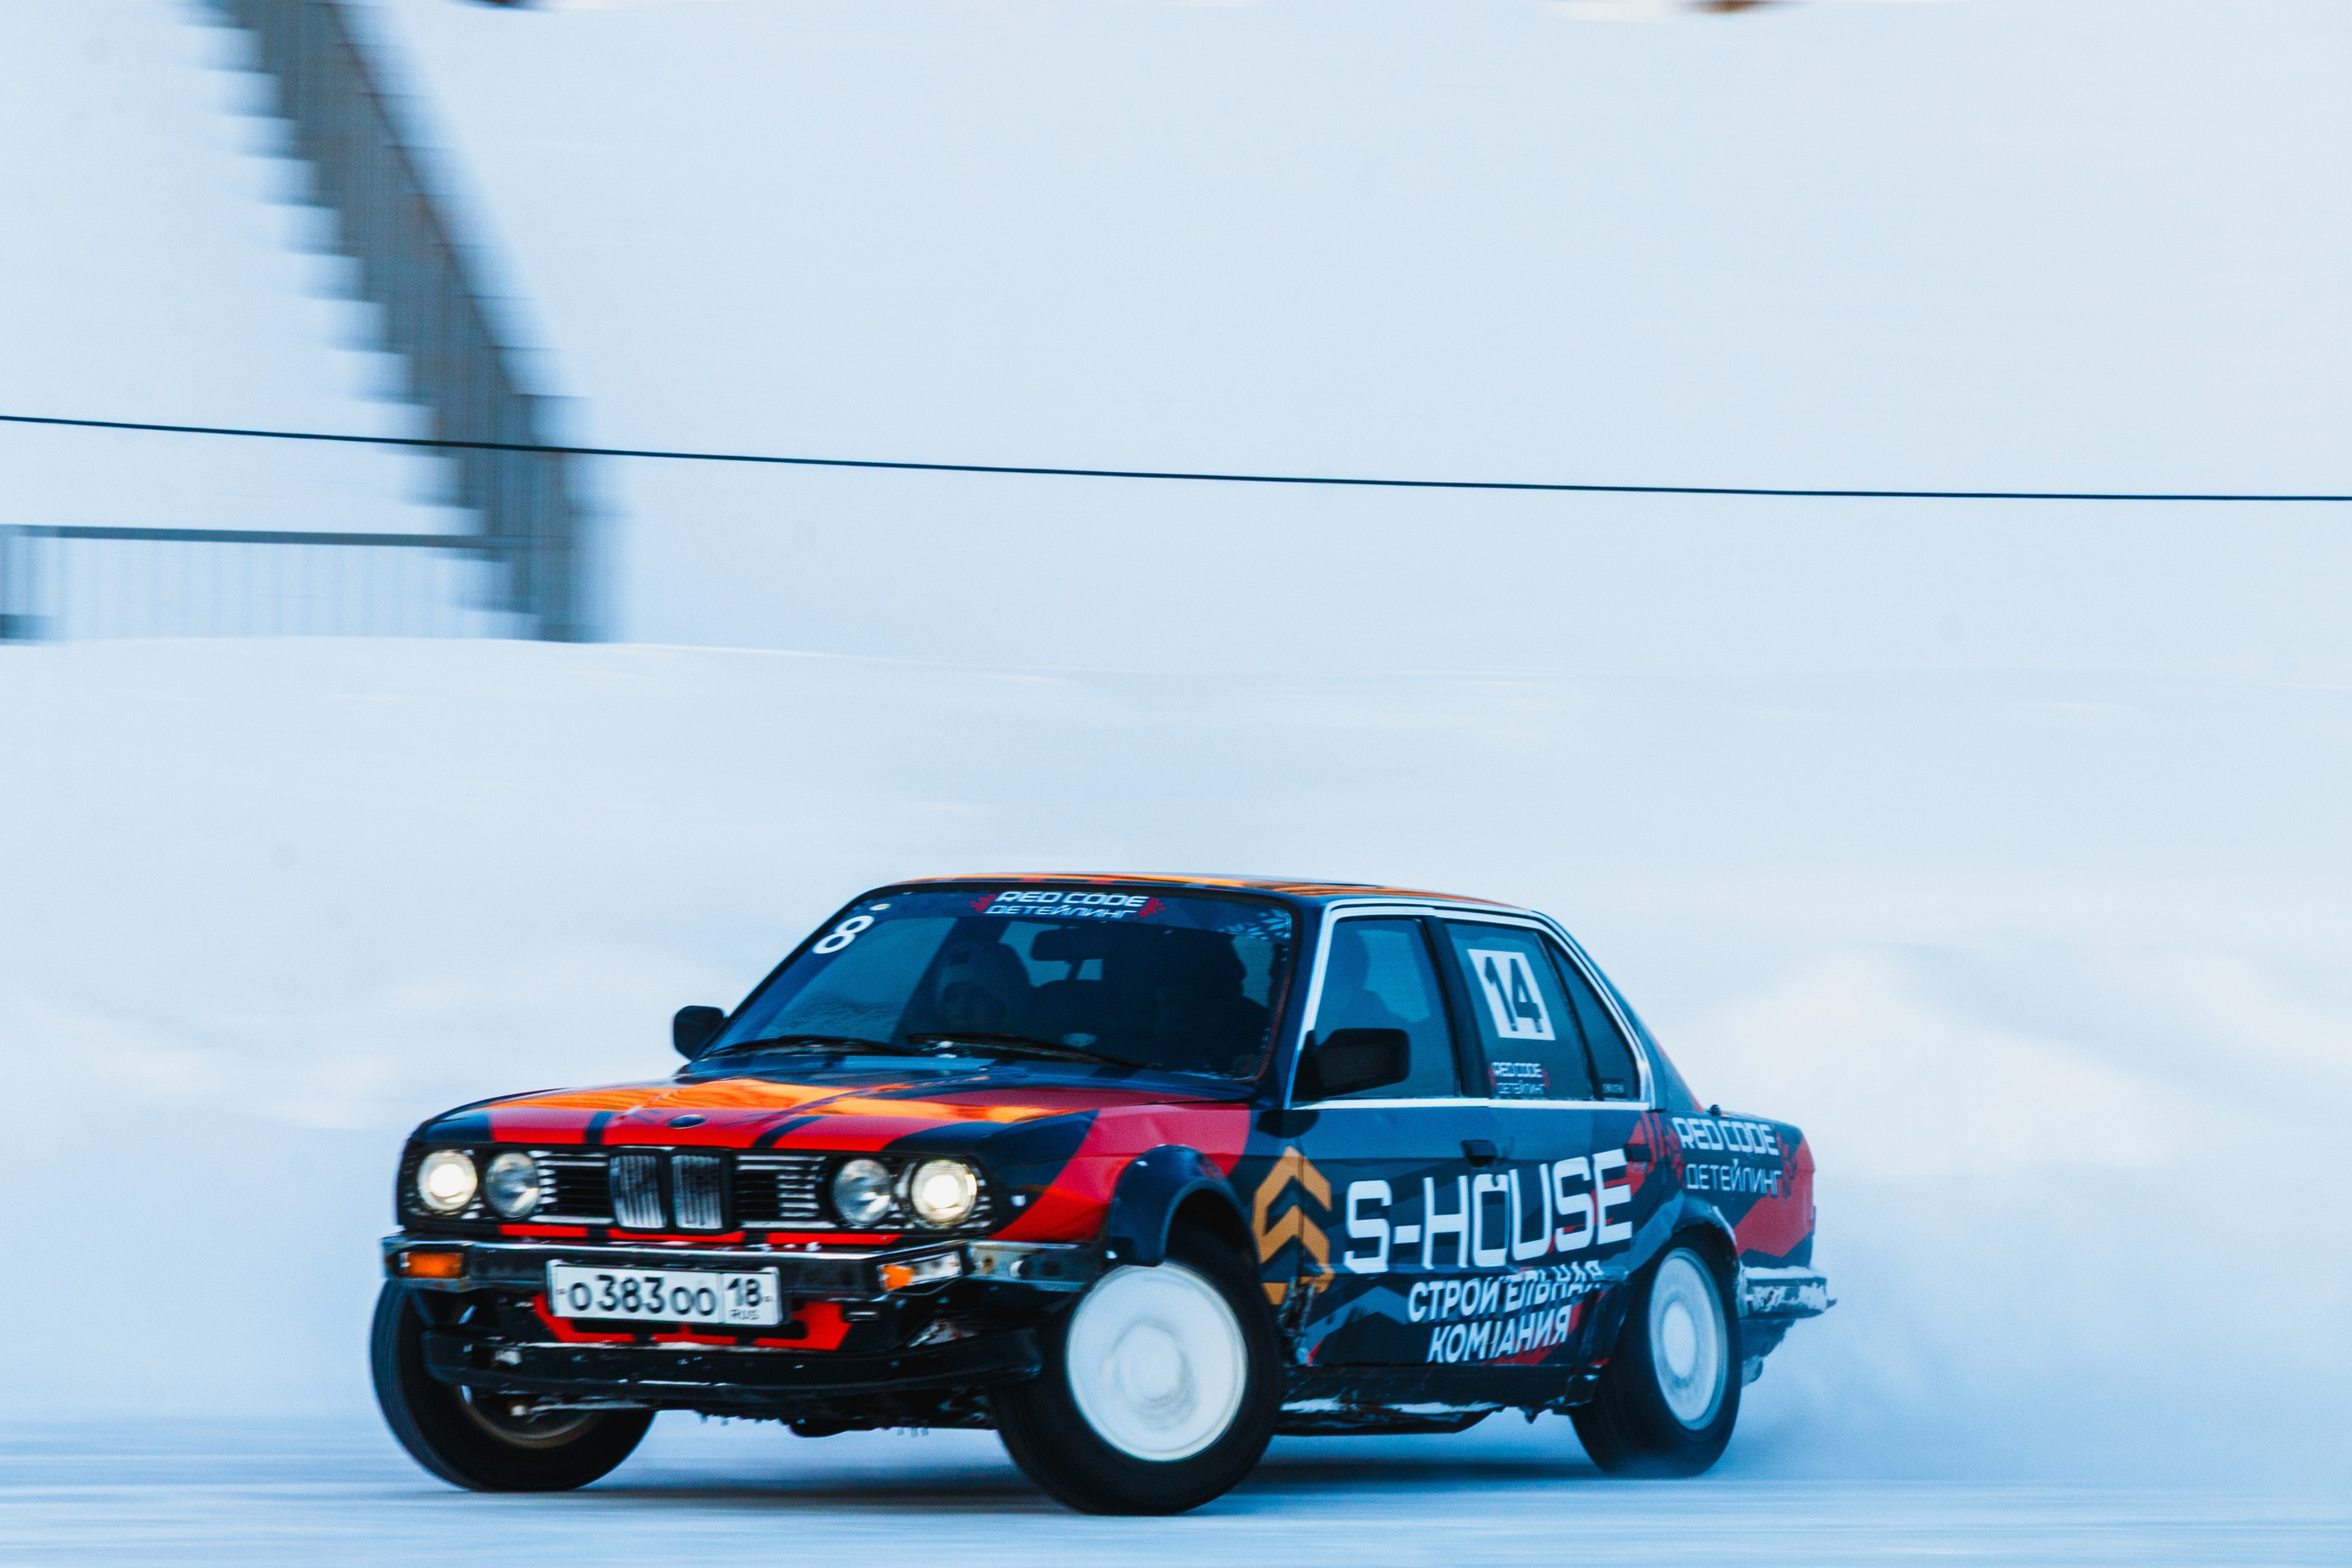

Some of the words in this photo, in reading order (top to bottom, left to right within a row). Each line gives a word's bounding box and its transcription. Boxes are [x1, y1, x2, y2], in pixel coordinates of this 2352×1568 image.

[995, 891, 1061, 903] RED
[1064, 892, 1148, 907] CODE
[811, 915, 875, 954] 8
[1484, 956, 1544, 1033] 14
[1671, 1117, 1724, 1150] RED
[1718, 1120, 1781, 1156] CODE
[1343, 1148, 1634, 1273] S-HOUSE
[727, 1278, 763, 1307] 18
[1408, 1260, 1605, 1323] СТРОИЕЛЬНАЯ
